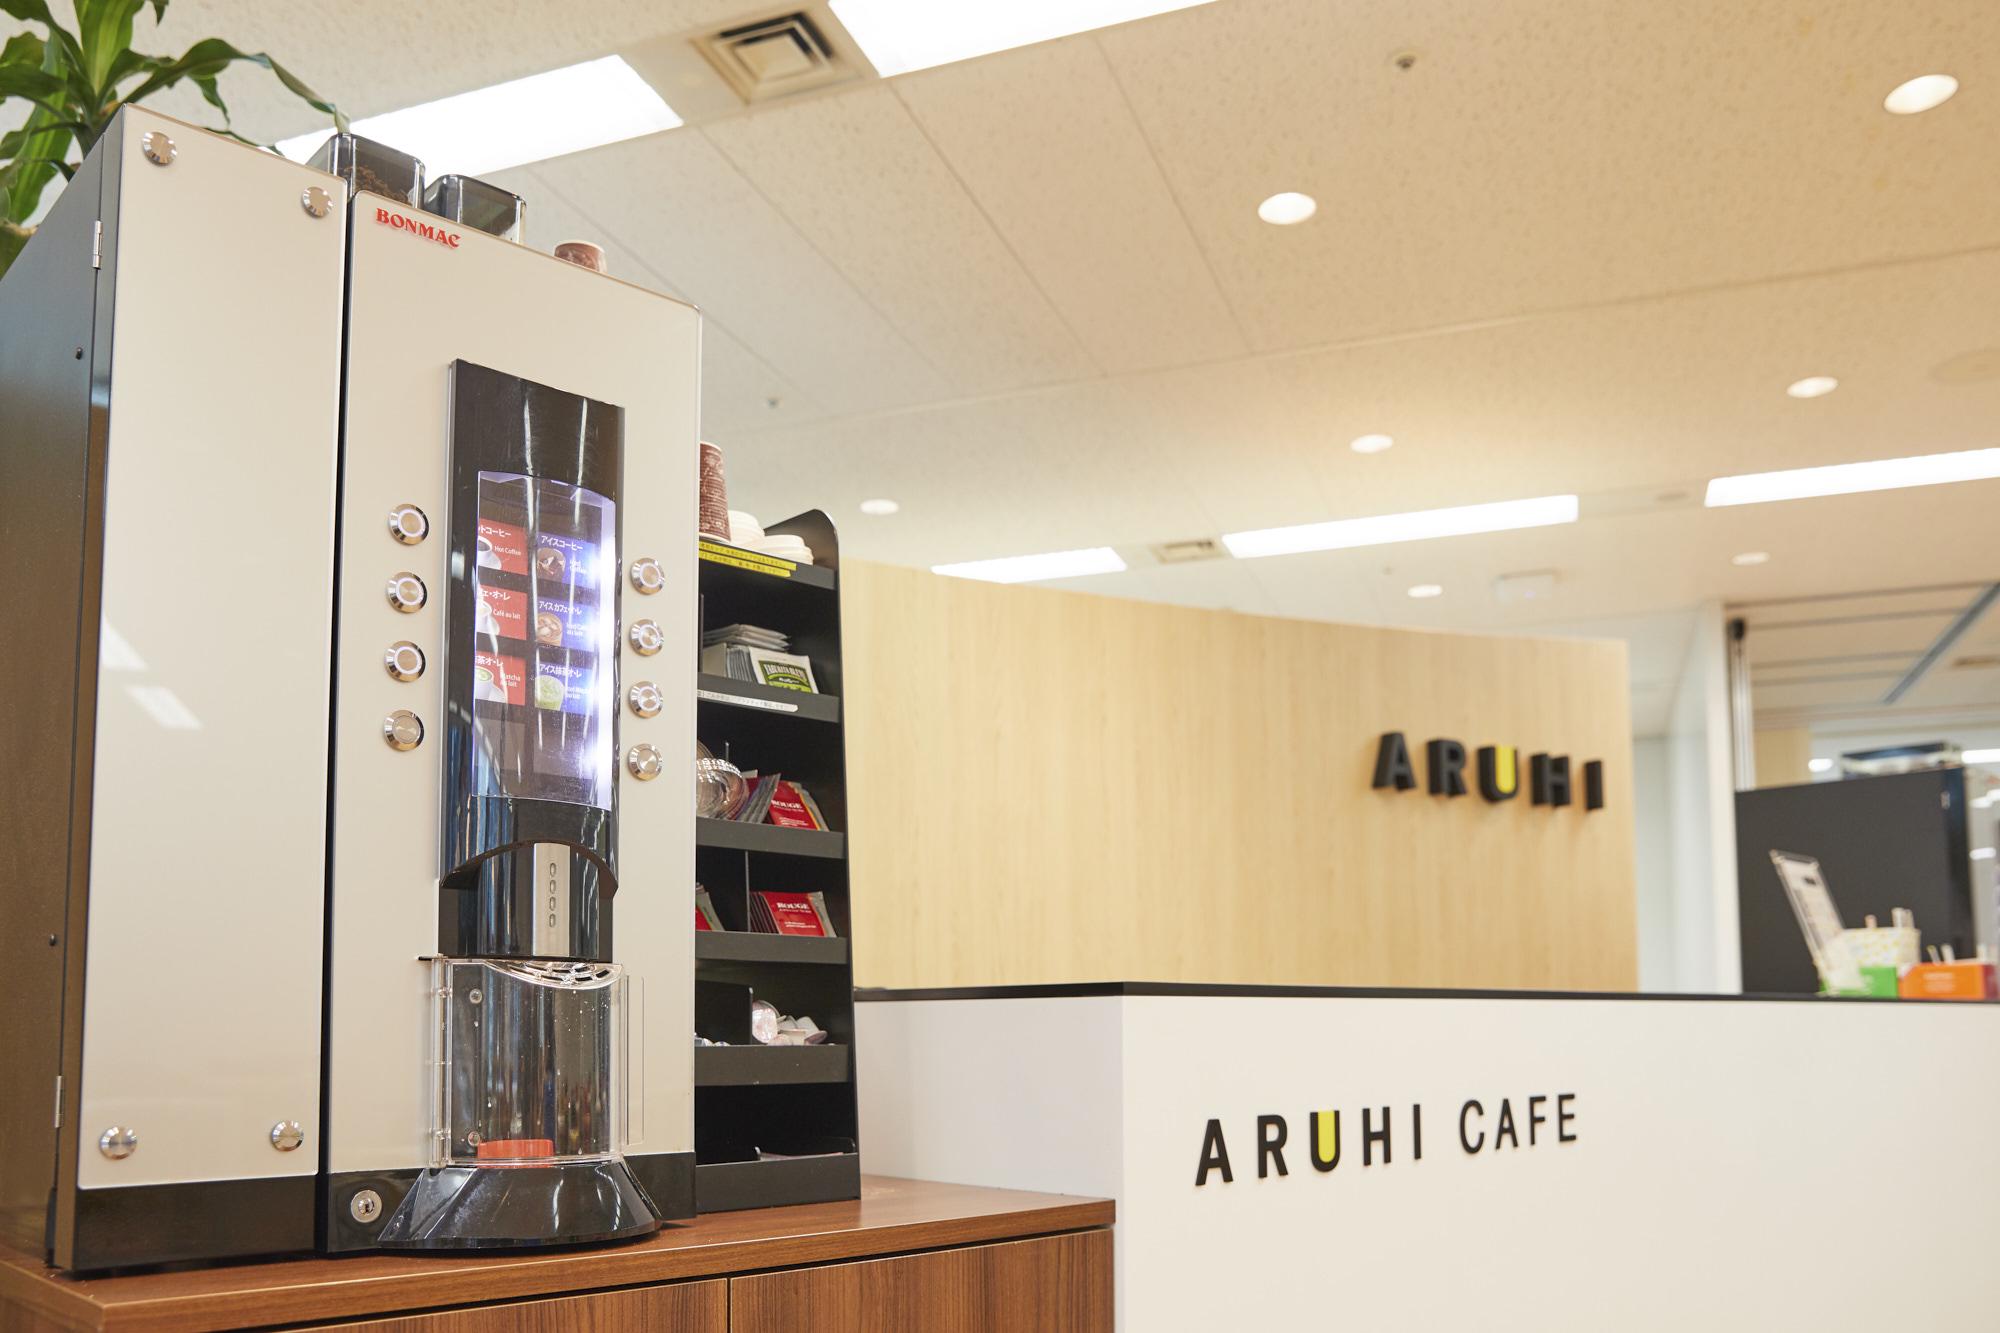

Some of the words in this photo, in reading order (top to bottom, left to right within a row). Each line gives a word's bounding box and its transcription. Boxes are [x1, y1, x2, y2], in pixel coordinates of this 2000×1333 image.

[376, 208, 461, 249] BONMAC
[478, 524, 512, 538] トコーヒー
[541, 535, 584, 551] アイスコーヒー
[494, 545, 504, 553] Hot
[504, 547, 522, 556] Coffee
[1371, 730, 1603, 811] ARUHI
[1195, 1104, 1422, 1186] ARUHI
[1459, 1093, 1578, 1154] CAFE
